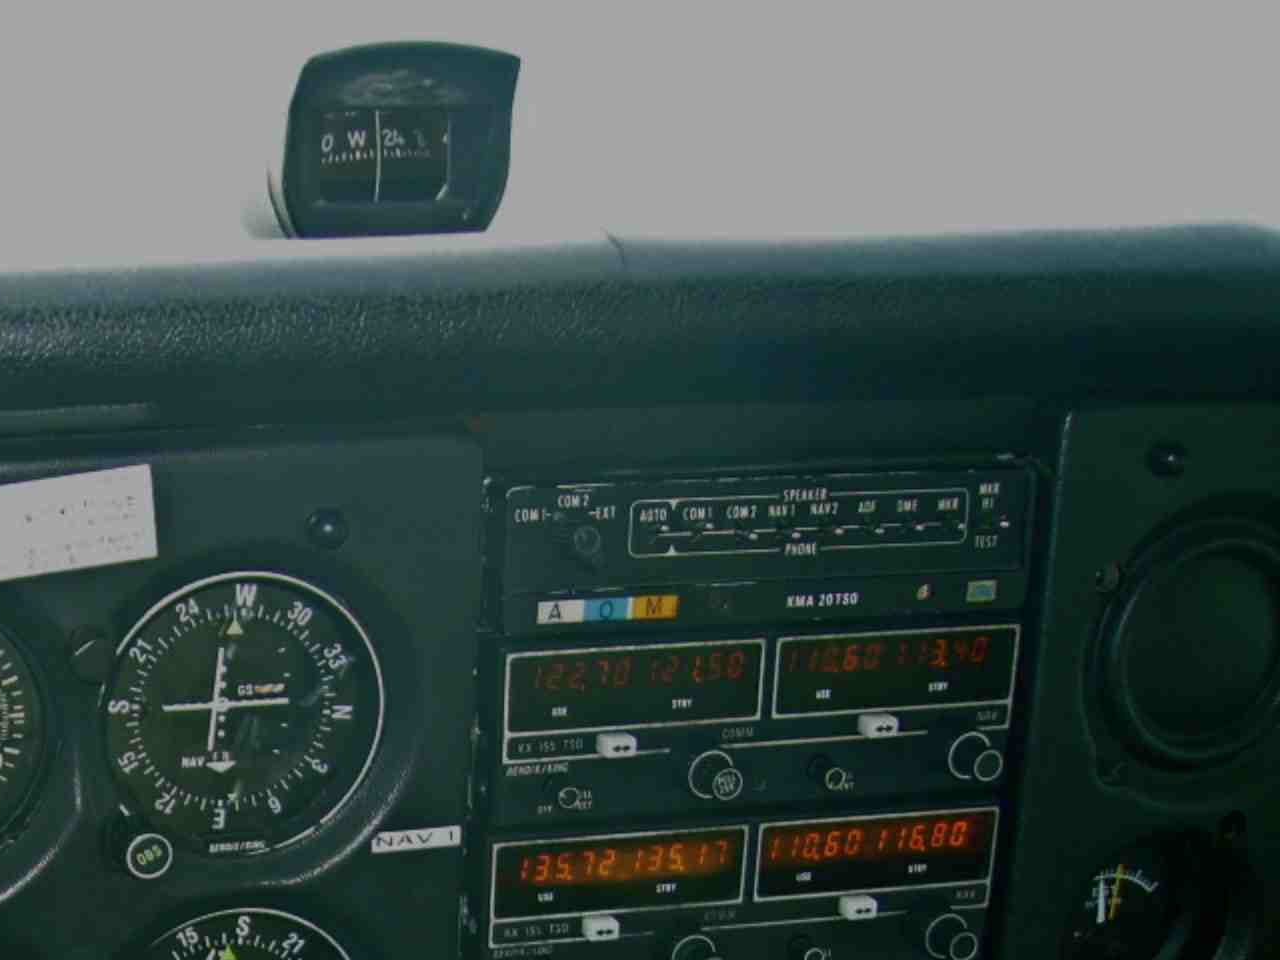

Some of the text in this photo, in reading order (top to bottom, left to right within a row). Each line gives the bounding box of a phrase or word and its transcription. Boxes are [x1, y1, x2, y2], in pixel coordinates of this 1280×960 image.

[783, 487, 827, 502] SPEAKER
[639, 508, 668, 523] AUTO
[783, 541, 817, 557] PHONE
[235, 583, 257, 606] W
[175, 598, 200, 622] 24
[287, 601, 313, 625] 30
[645, 598, 662, 616] M
[129, 638, 153, 662] 21
[324, 643, 348, 670] 33
[108, 699, 130, 714] S
[331, 703, 353, 720] N
[267, 794, 283, 815] 6
[211, 808, 226, 830] E
[376, 831, 433, 848] NAV
[176, 926, 201, 947] 15
[234, 915, 252, 938] S
[280, 933, 305, 954] 21
